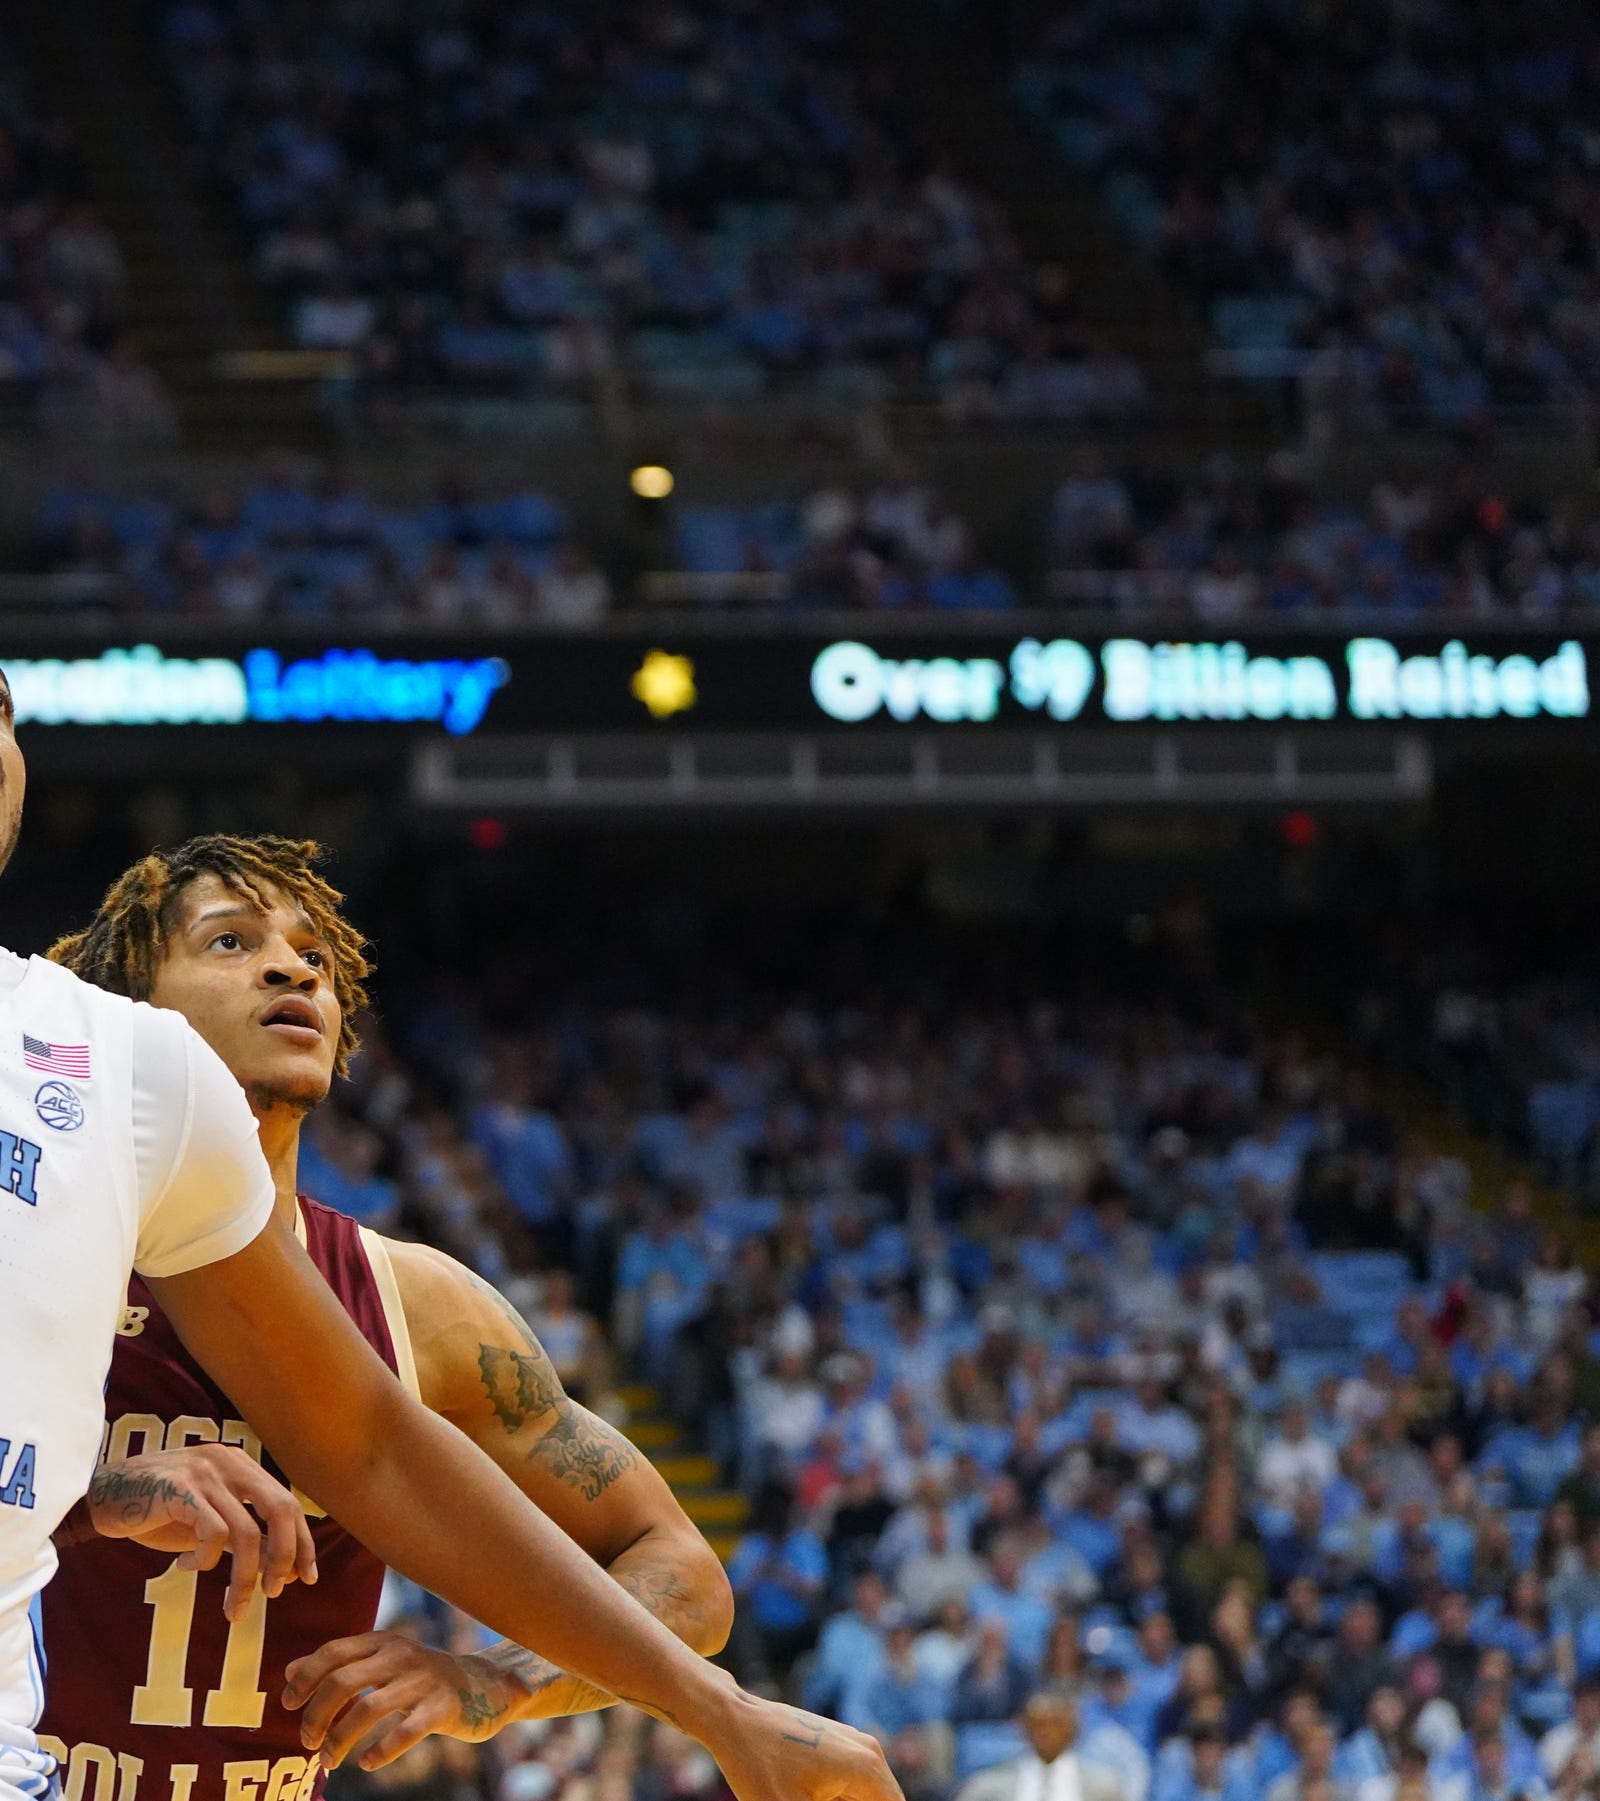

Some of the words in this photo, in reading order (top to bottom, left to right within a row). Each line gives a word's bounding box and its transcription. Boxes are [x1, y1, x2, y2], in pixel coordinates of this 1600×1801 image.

[243, 646, 509, 735] Lottery
[811, 641, 1004, 722] Over
[1009, 637, 1096, 722] $9
[1100, 638, 1338, 722] Billion
[1345, 637, 1590, 719] Raised
[42, 1096, 81, 1117] ACC
[130, 1558, 268, 1728] 11
